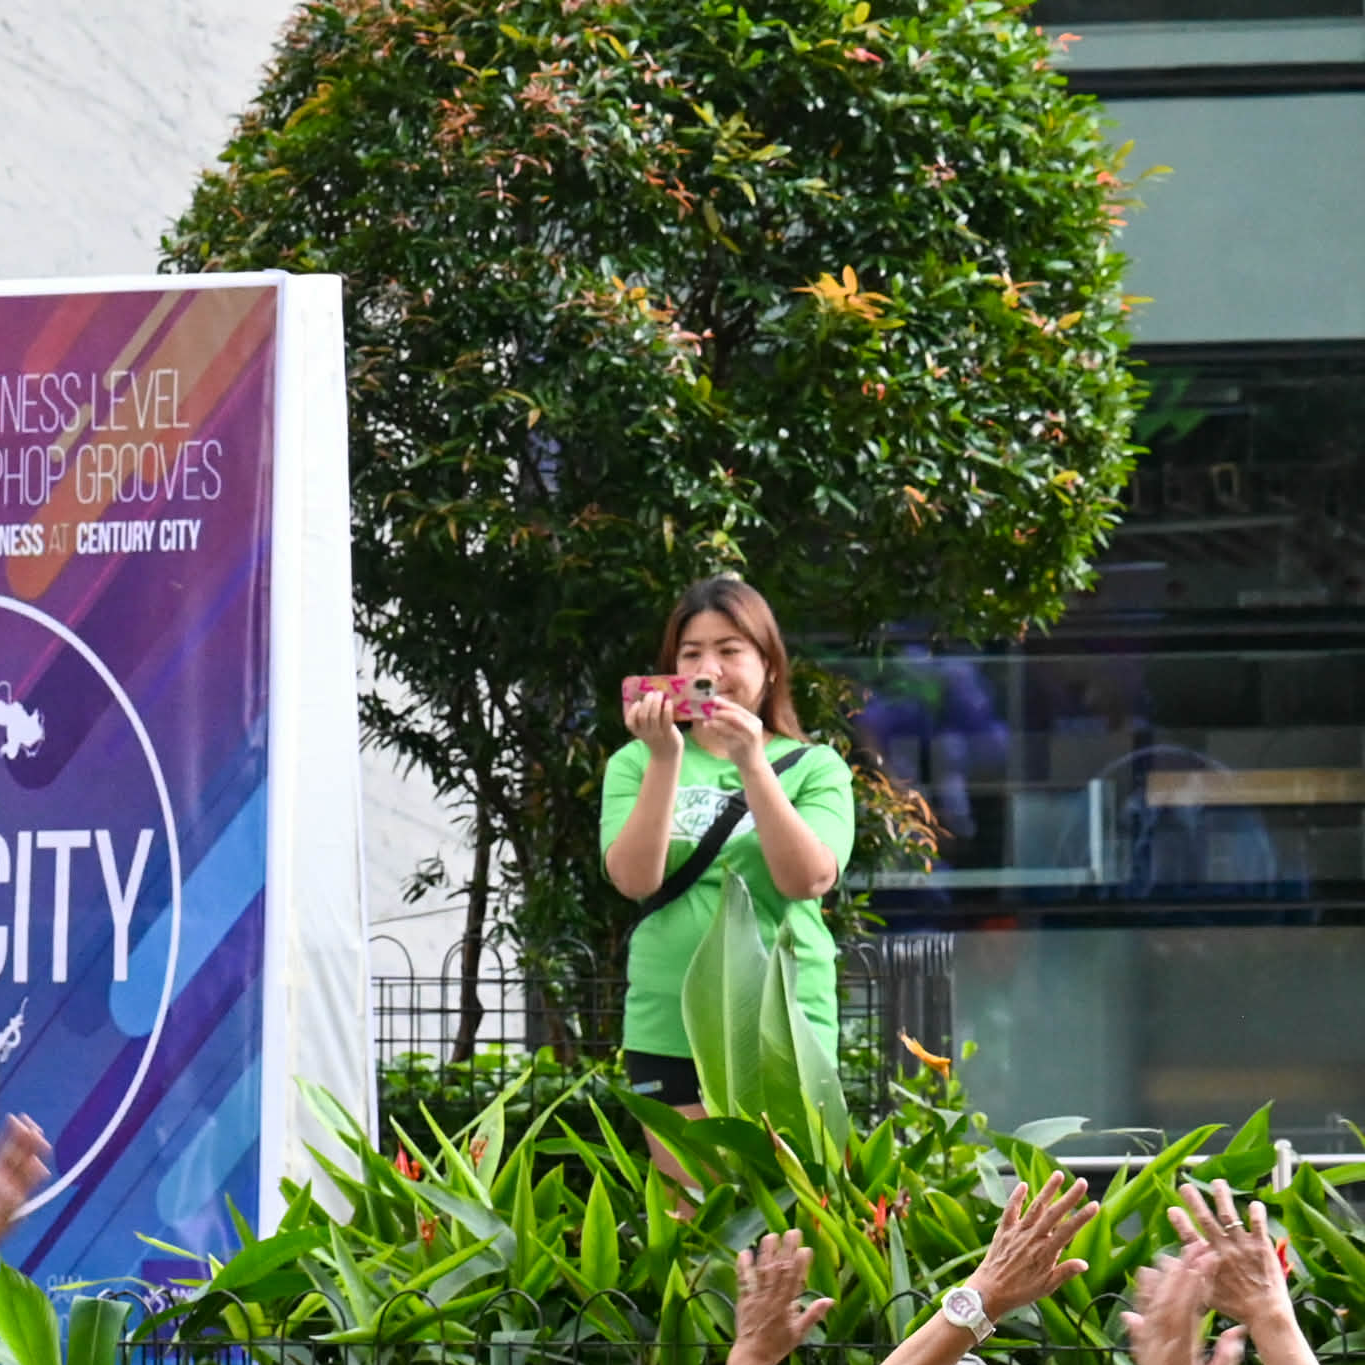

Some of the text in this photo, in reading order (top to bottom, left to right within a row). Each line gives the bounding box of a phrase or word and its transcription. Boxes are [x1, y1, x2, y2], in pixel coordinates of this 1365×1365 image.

[90, 368, 190, 431] LEVEL
[75, 439, 223, 504] GROOVES
[48, 522, 70, 553] AT
[75, 520, 156, 555] CENTURY
[159, 518, 202, 552] CITY
